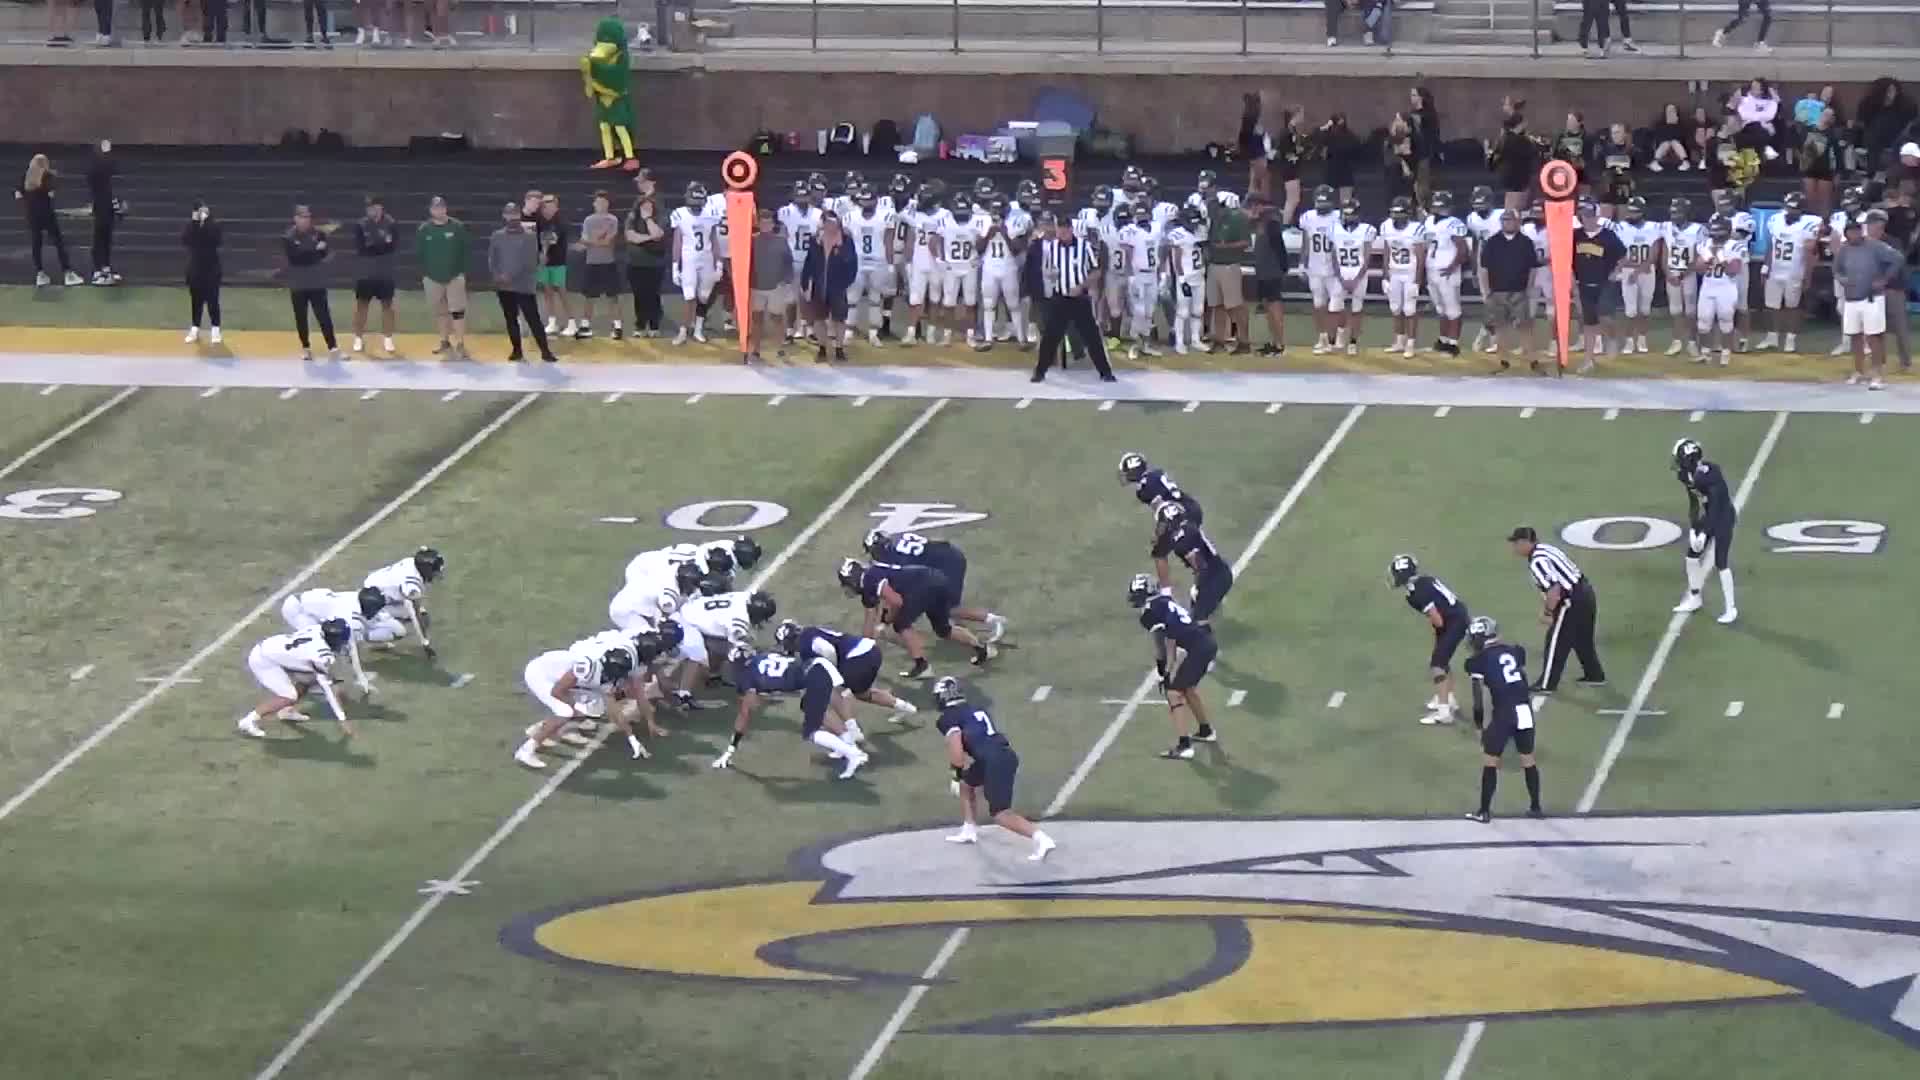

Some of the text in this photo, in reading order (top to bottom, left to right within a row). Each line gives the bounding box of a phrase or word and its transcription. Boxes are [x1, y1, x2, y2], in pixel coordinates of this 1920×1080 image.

[1043, 160, 1066, 190] 3
[694, 231, 704, 251] 3
[863, 235, 872, 254] 8
[991, 241, 1004, 259] 11
[1431, 239, 1439, 258] 7
[1339, 247, 1359, 266] 25
[1671, 246, 1690, 266] 54
[704, 600, 731, 611] 8
[1499, 653, 1522, 684] 2
